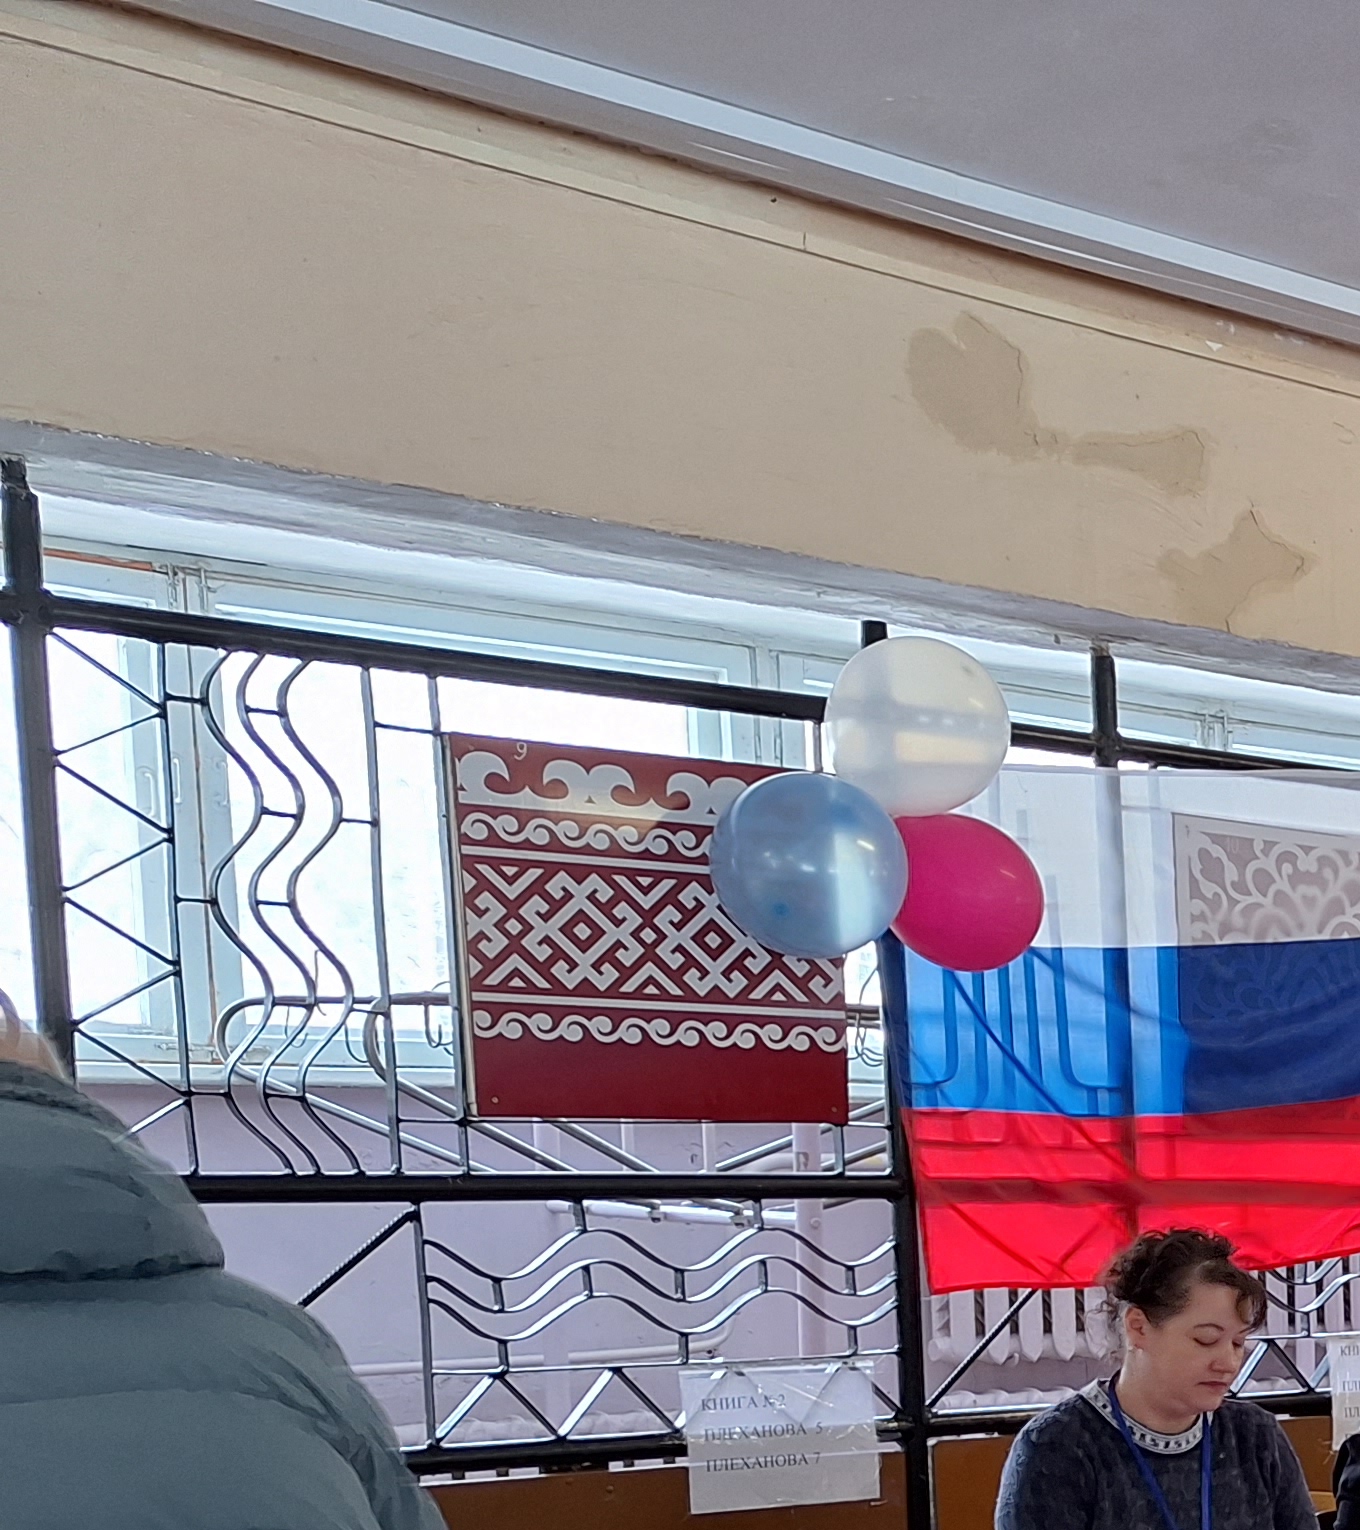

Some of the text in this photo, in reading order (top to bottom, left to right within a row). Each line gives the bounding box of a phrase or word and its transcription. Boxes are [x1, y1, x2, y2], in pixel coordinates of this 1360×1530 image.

[513, 741, 528, 761] 9
[701, 1395, 759, 1411] КНИГА
[704, 1421, 823, 1442] ПЛЕХАНОВА 5
[706, 1452, 821, 1473] ПЛЕХАНОВА 7
